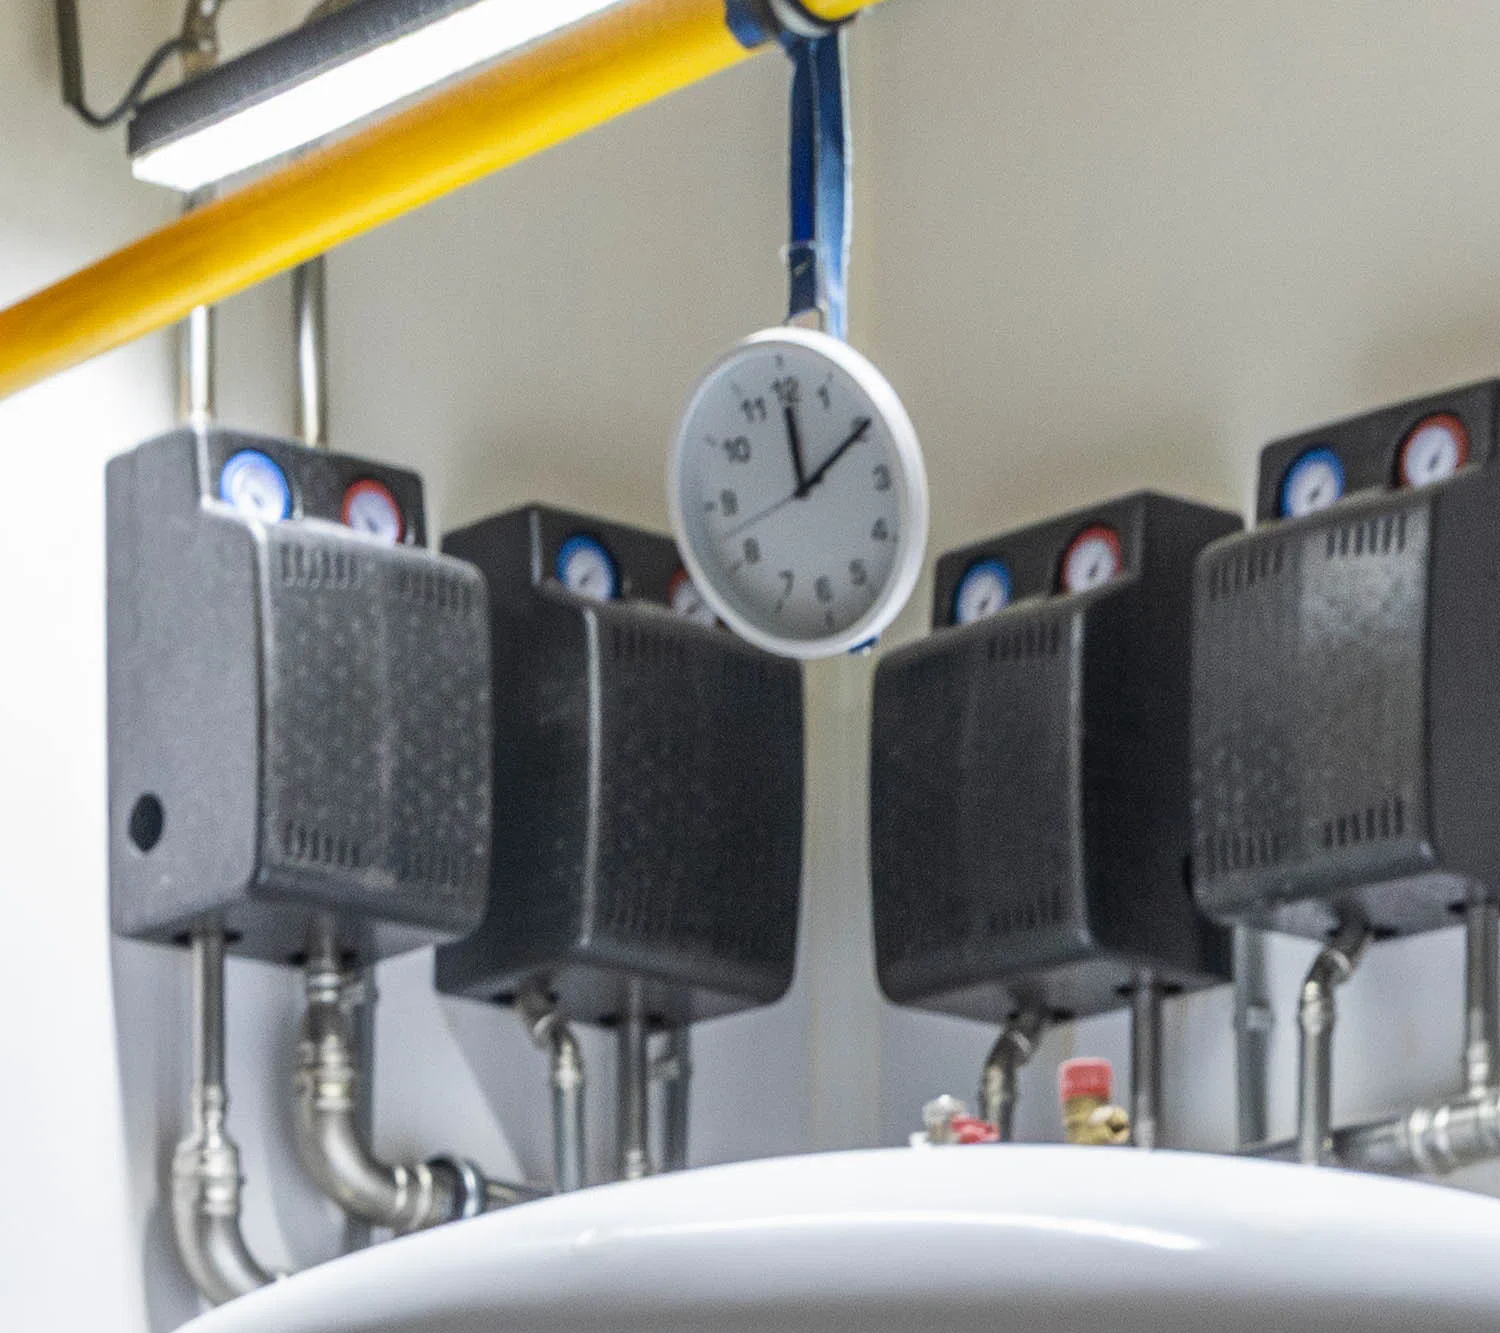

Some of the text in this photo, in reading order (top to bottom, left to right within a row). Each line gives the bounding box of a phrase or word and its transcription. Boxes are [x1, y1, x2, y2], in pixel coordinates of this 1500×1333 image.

[771, 376, 800, 406] 12
[817, 384, 831, 409] 1
[740, 397, 767, 423] 11
[724, 436, 751, 464] 10
[873, 463, 892, 491] 3
[720, 488, 738, 517] 9
[871, 517, 889, 542] 4
[744, 536, 762, 564] 8
[779, 569, 795, 598] 7
[849, 558, 868, 587] 5
[814, 574, 832, 603] 6
